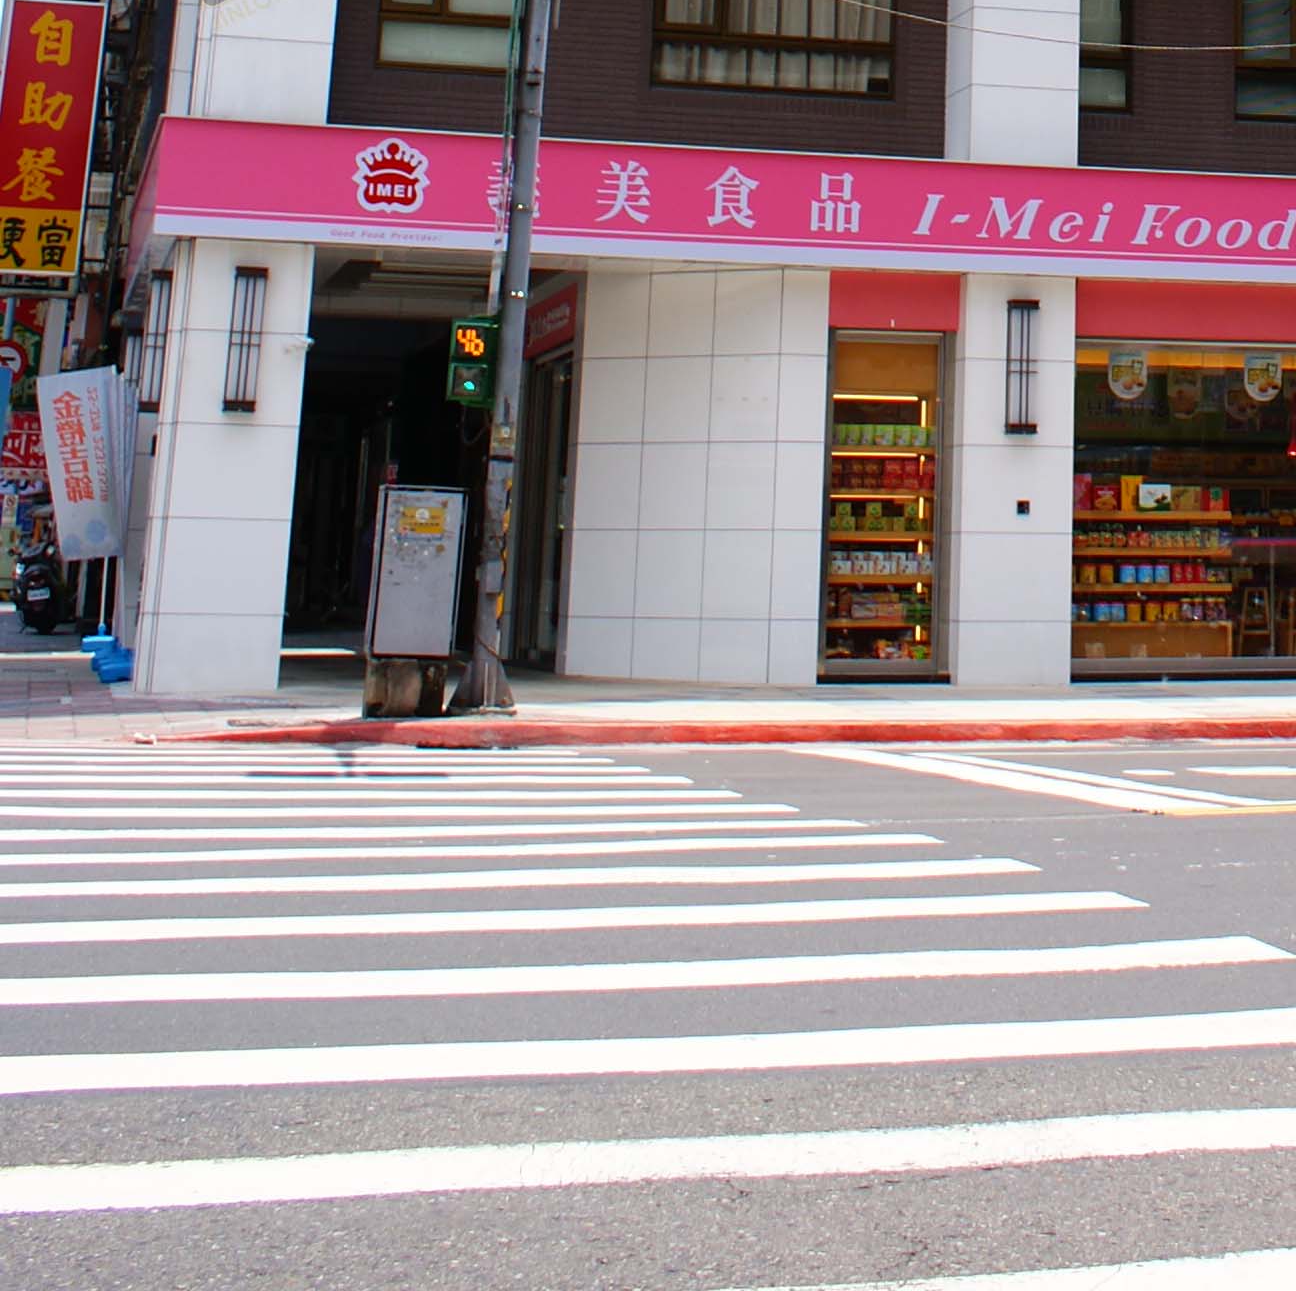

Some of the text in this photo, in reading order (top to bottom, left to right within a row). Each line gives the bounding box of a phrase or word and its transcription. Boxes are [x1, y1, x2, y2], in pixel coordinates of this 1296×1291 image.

[2, 10, 74, 203] 自助餐
[368, 183, 413, 199] IMEI
[911, 193, 1113, 244] I-Mei
